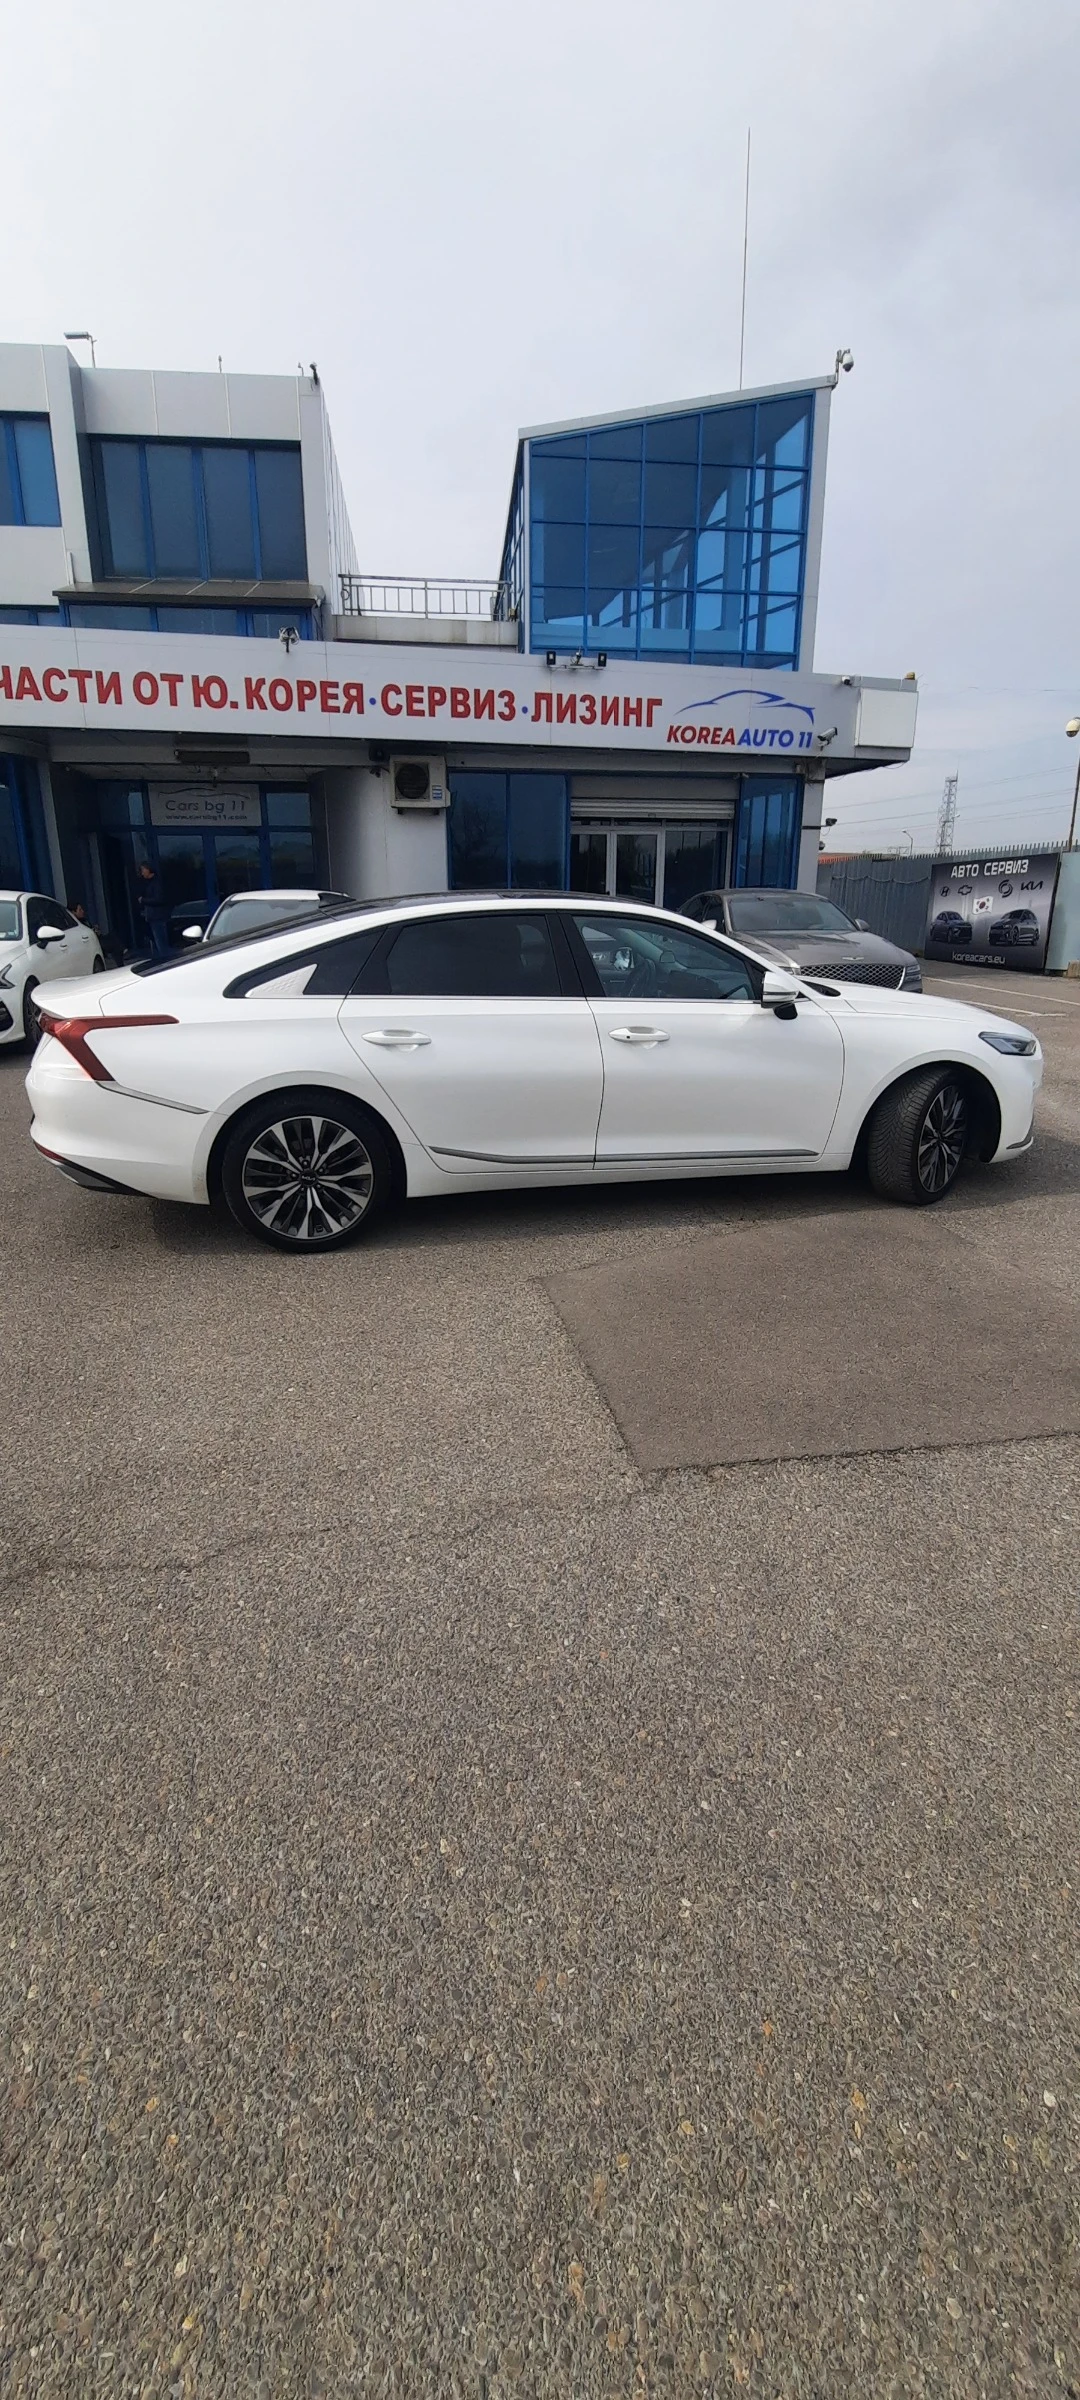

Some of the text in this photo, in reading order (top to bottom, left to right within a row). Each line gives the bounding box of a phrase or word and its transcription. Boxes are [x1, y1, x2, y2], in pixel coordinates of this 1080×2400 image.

[132, 671, 184, 707] ОТ
[244, 677, 365, 715] КОРЕЯ
[380, 684, 516, 722] СЕРВИЗ
[531, 692, 663, 728] ЛИЗИНГ
[798, 731, 813, 748] 11
[165, 800, 199, 811] Cars
[205, 801, 225, 813] bg
[950, 860, 1029, 878] АВТО СЕРВИЗ
[952, 951, 1006, 965] koreacars.eu
